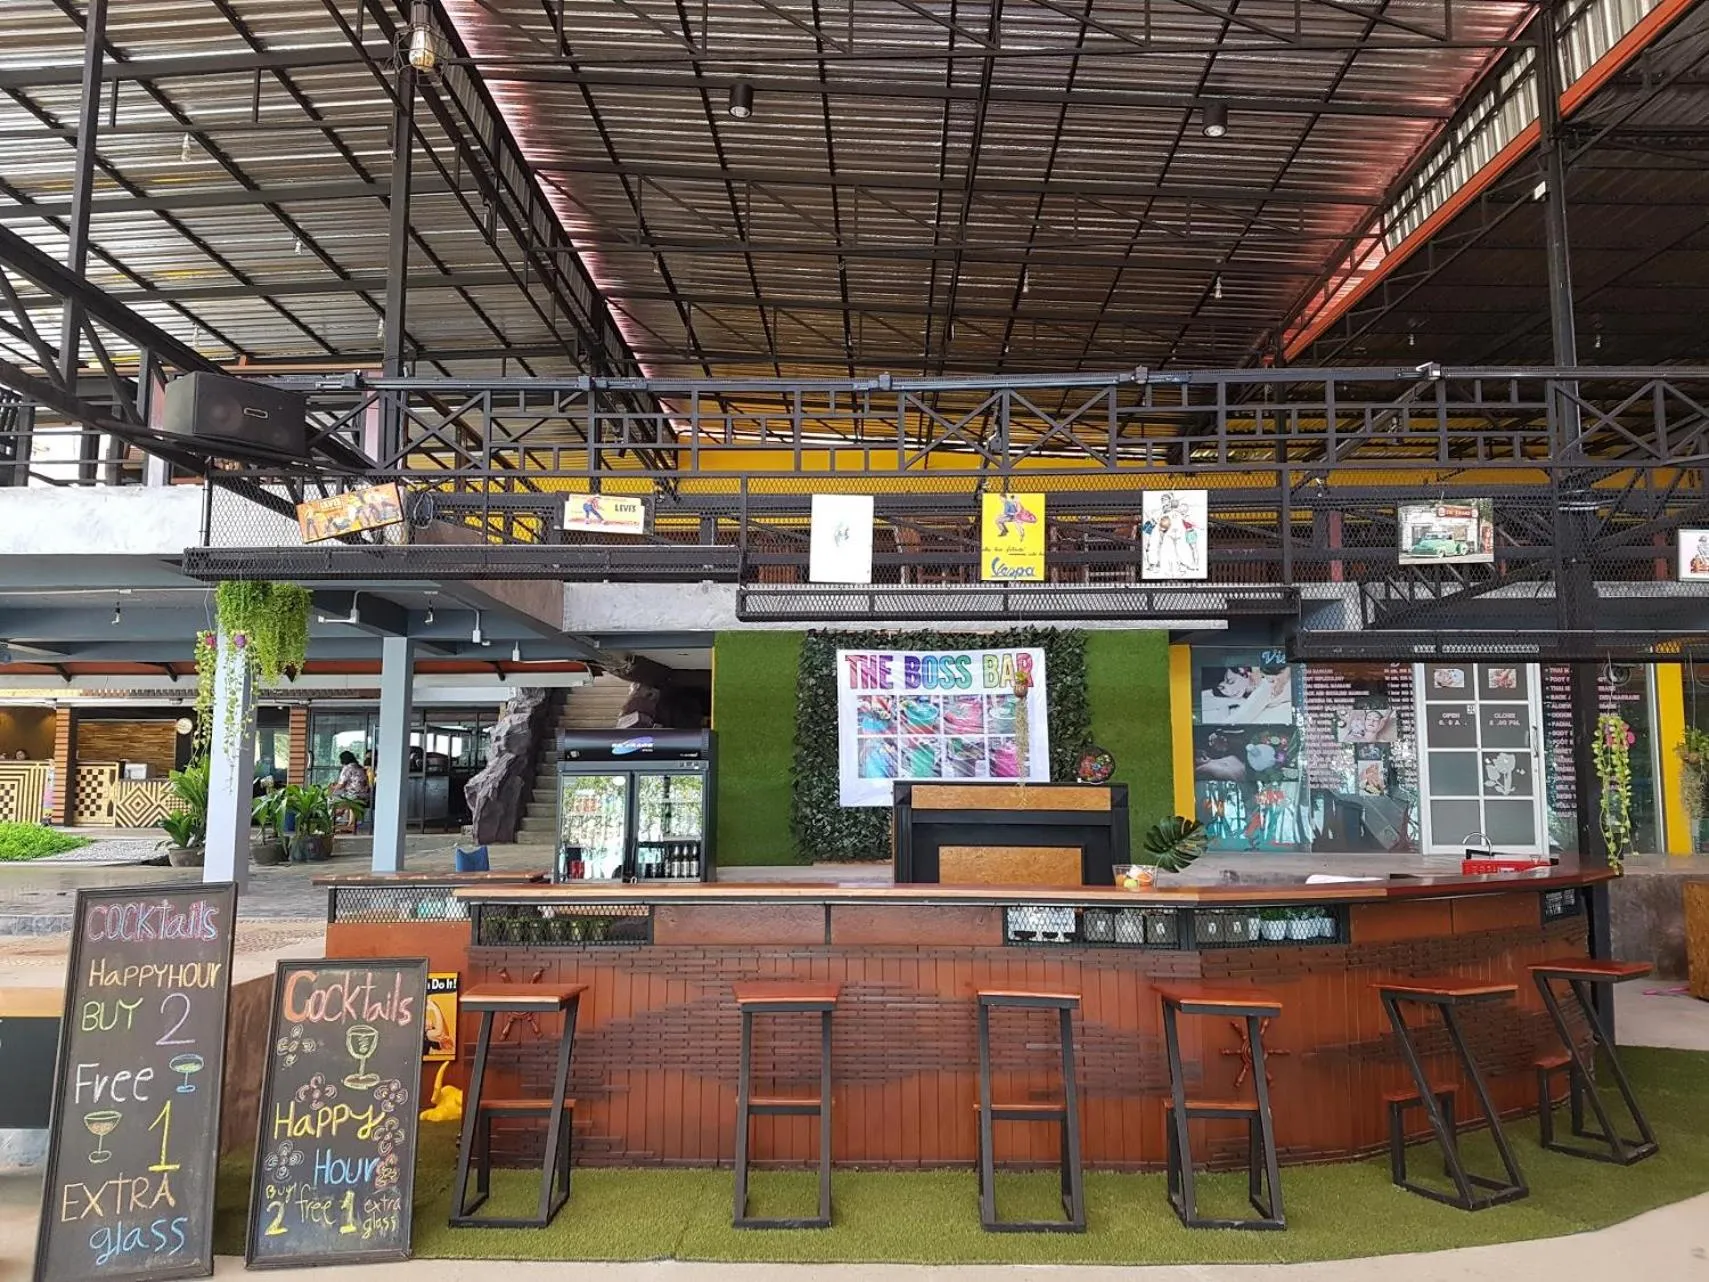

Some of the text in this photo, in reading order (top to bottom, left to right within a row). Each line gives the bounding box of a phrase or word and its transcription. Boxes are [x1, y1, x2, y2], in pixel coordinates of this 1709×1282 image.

[991, 556, 1036, 579] Vespa
[845, 652, 1034, 690] THE BOSS BAR
[431, 978, 445, 990] Do
[81, 992, 196, 1046] BUY 2
[74, 1062, 154, 1104] Free
[147, 1099, 180, 1172] 1
[61, 1171, 176, 1222] EXTRA
[264, 1200, 289, 1236] 2
[339, 1189, 358, 1235] 1
[89, 1216, 188, 1266] glass
